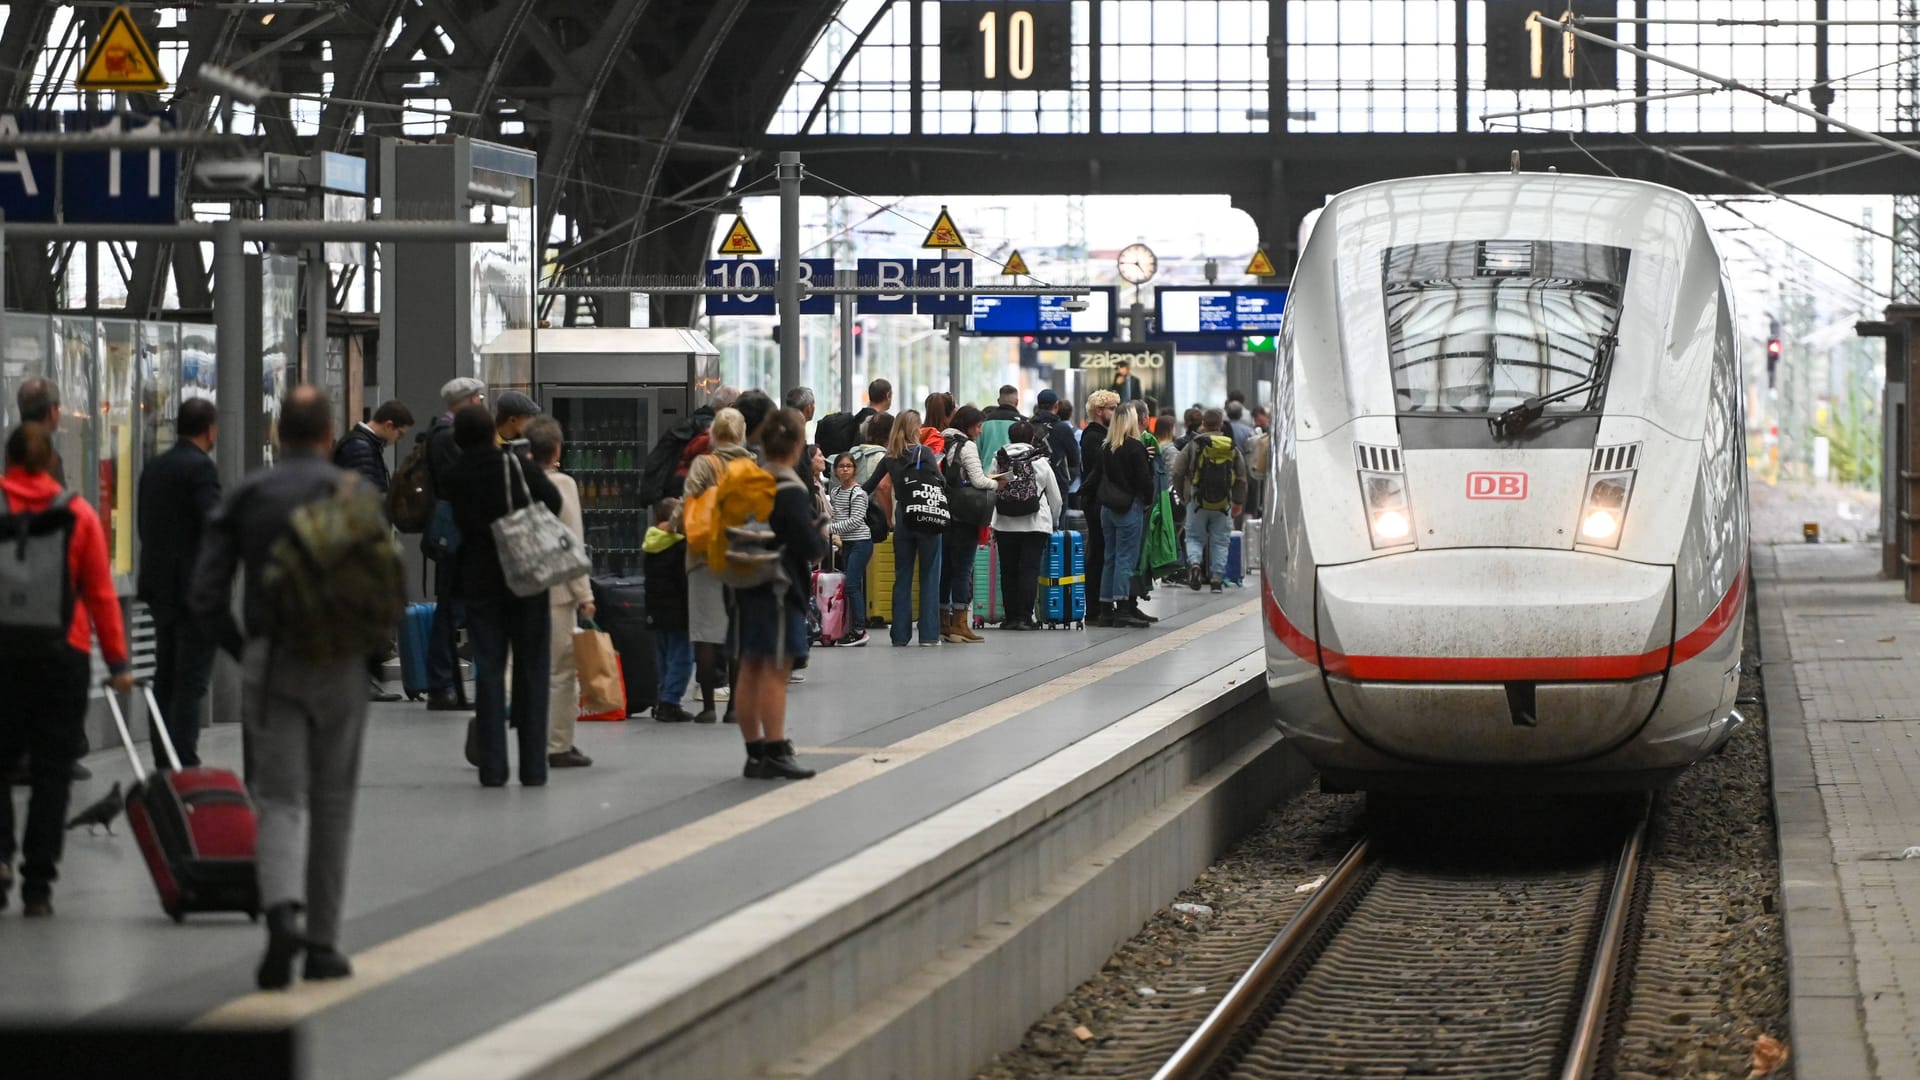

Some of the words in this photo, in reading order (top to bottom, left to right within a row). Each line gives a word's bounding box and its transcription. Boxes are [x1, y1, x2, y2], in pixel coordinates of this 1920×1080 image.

[979, 10, 1034, 80] 10
[1525, 10, 1575, 78] 11
[91, 115, 161, 197] 11
[712, 262, 760, 303] 10
[877, 262, 905, 301] B
[930, 262, 966, 301] 11
[1080, 351, 1164, 369] zalando
[921, 483, 942, 495] THE
[1473, 475, 1521, 495] DB
[905, 504, 951, 520] FREEDOM
[926, 499, 940, 507] OF
